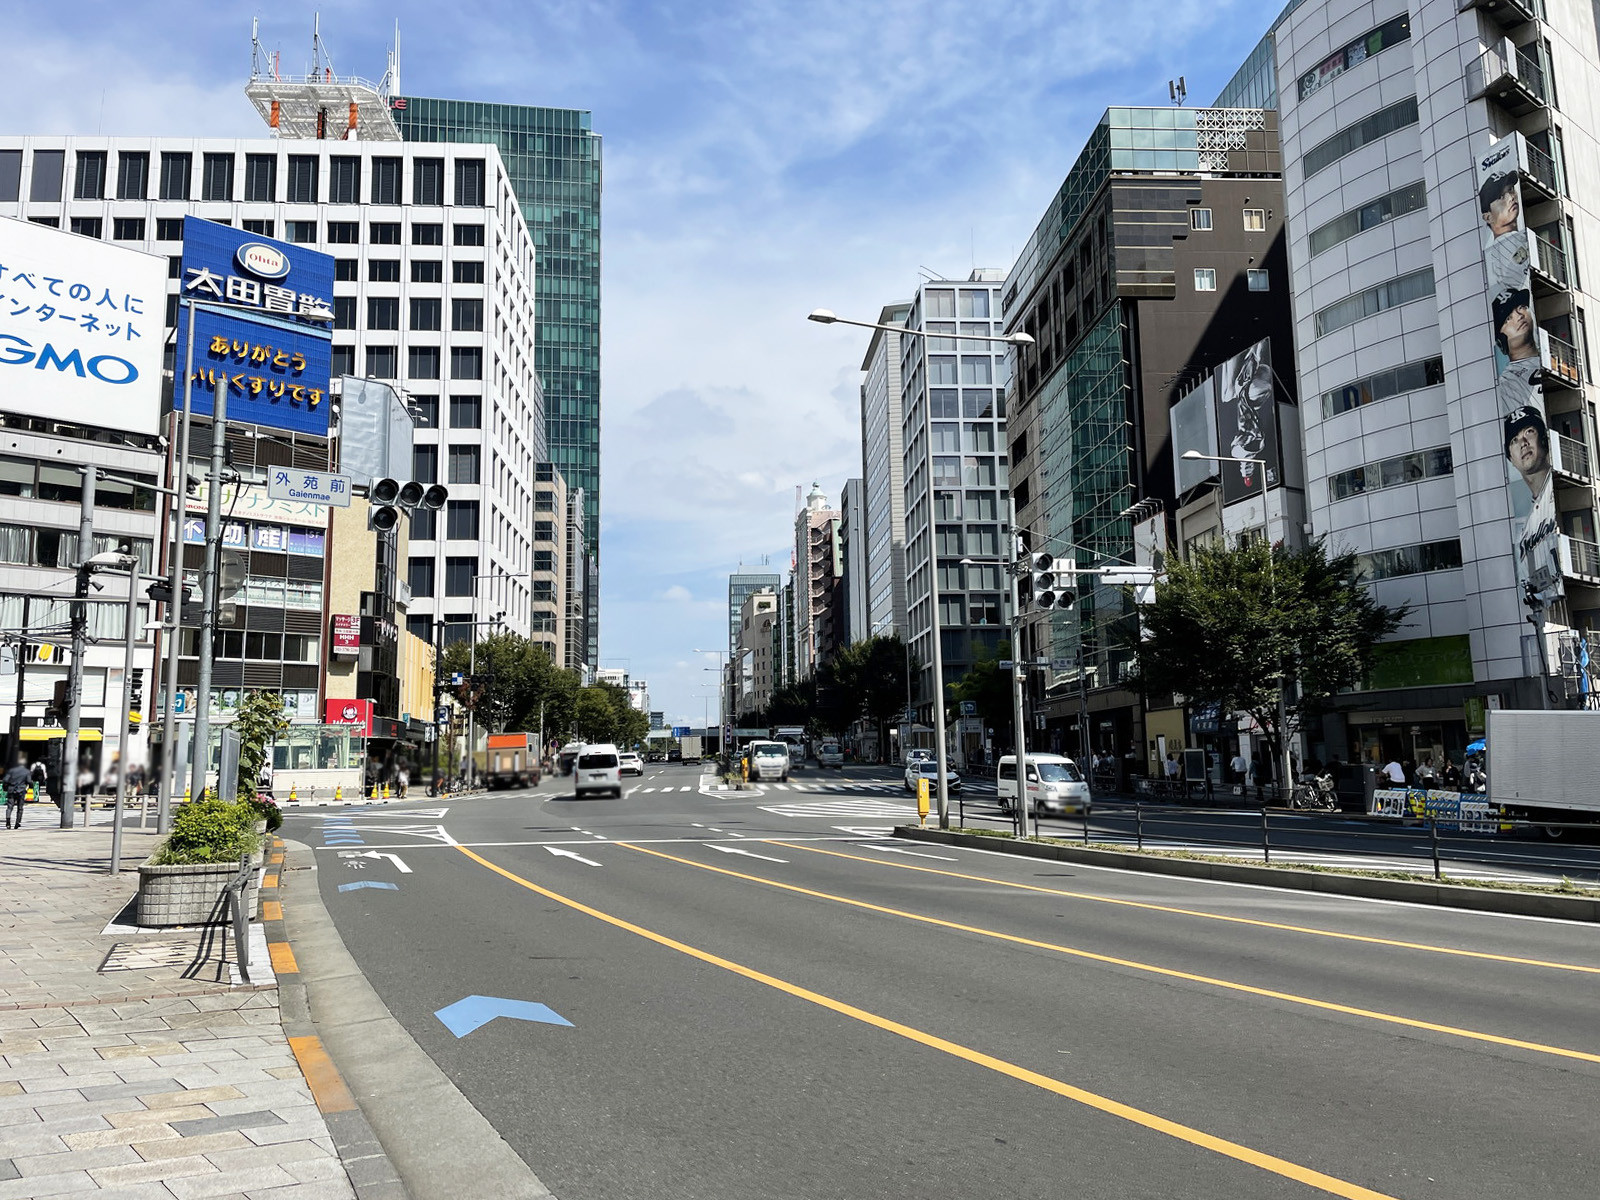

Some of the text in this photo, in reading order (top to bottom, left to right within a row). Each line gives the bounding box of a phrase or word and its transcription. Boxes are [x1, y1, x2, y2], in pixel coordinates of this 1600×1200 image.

[249, 252, 279, 267] Ohta
[0, 293, 141, 341] ンターネット
[0, 333, 139, 385] GMO
[210, 335, 307, 371] ありがとう
[275, 471, 346, 494] 外苑前
[288, 488, 331, 501] Gaienmae
